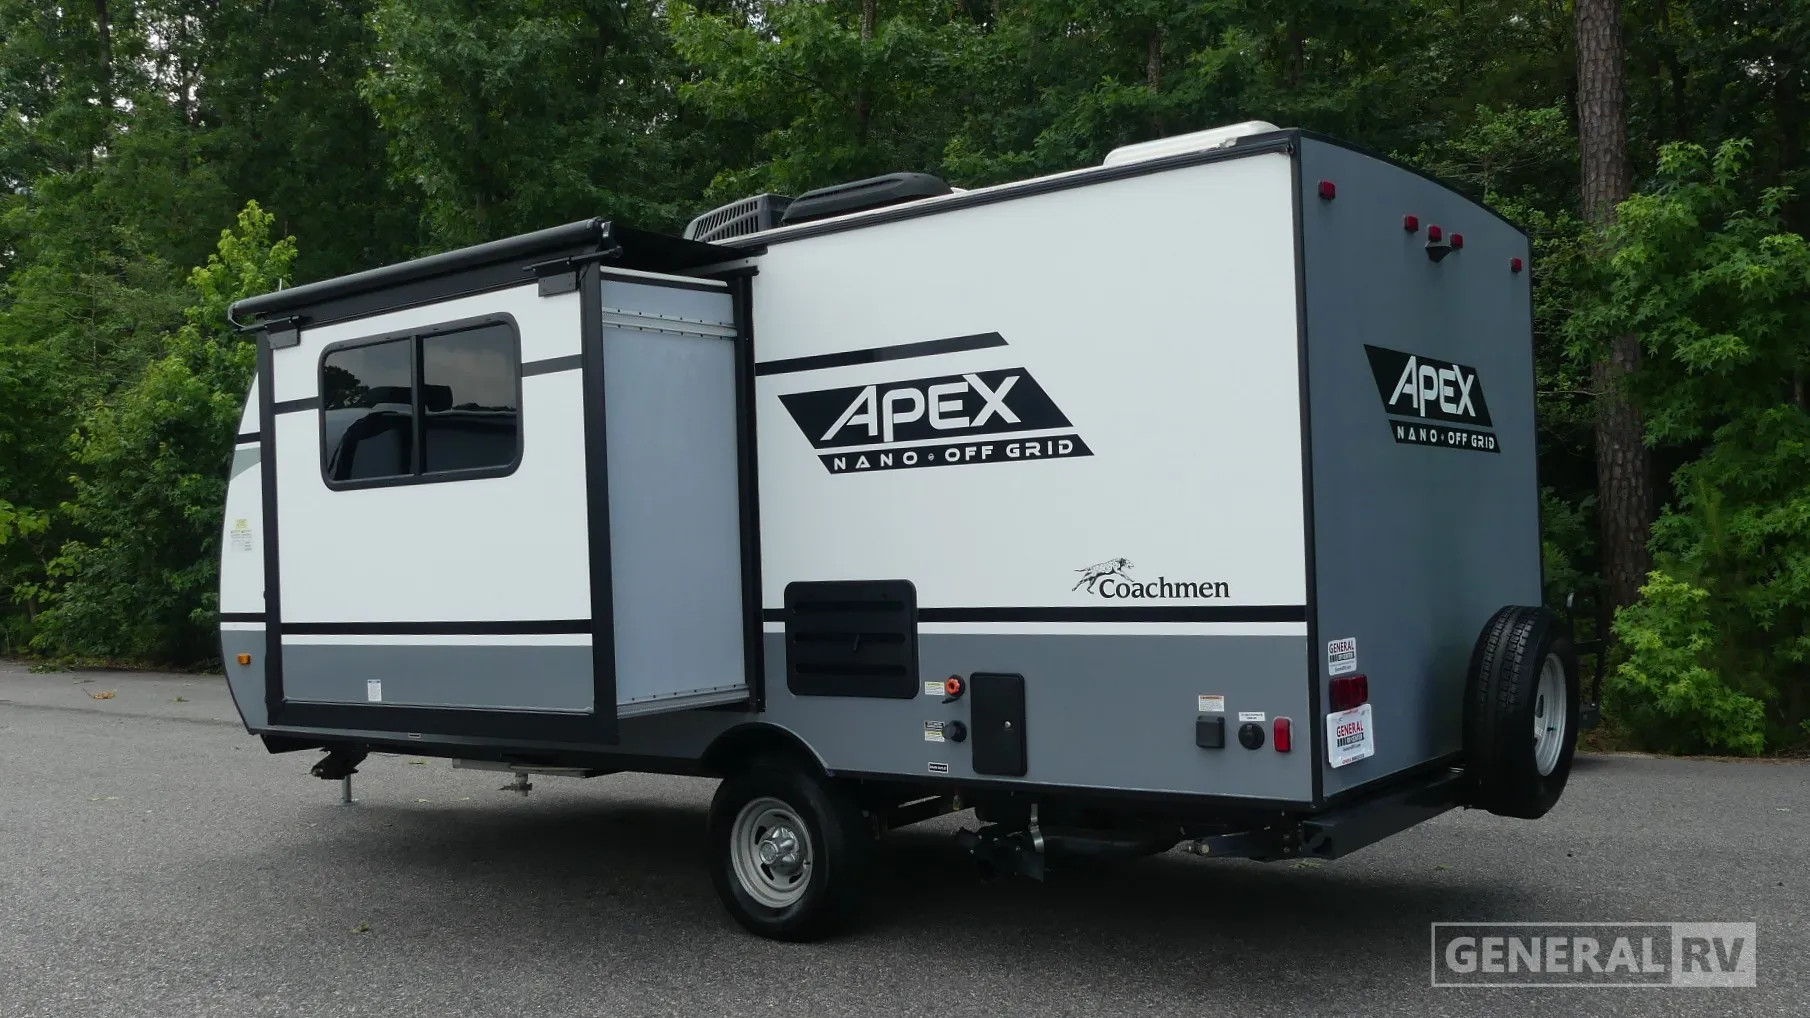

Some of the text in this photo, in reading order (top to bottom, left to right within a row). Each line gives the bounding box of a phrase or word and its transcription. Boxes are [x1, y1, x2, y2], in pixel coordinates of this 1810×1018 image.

[1388, 355, 1476, 418] APEX
[820, 373, 1022, 443] APEX
[1397, 425, 1495, 450] NANO OFF GRID
[833, 439, 1073, 471] NANO OFF GRID
[1098, 576, 1231, 599] Coachmen
[1329, 640, 1355, 654] GENERAL
[1336, 720, 1364, 738] GENERAL
